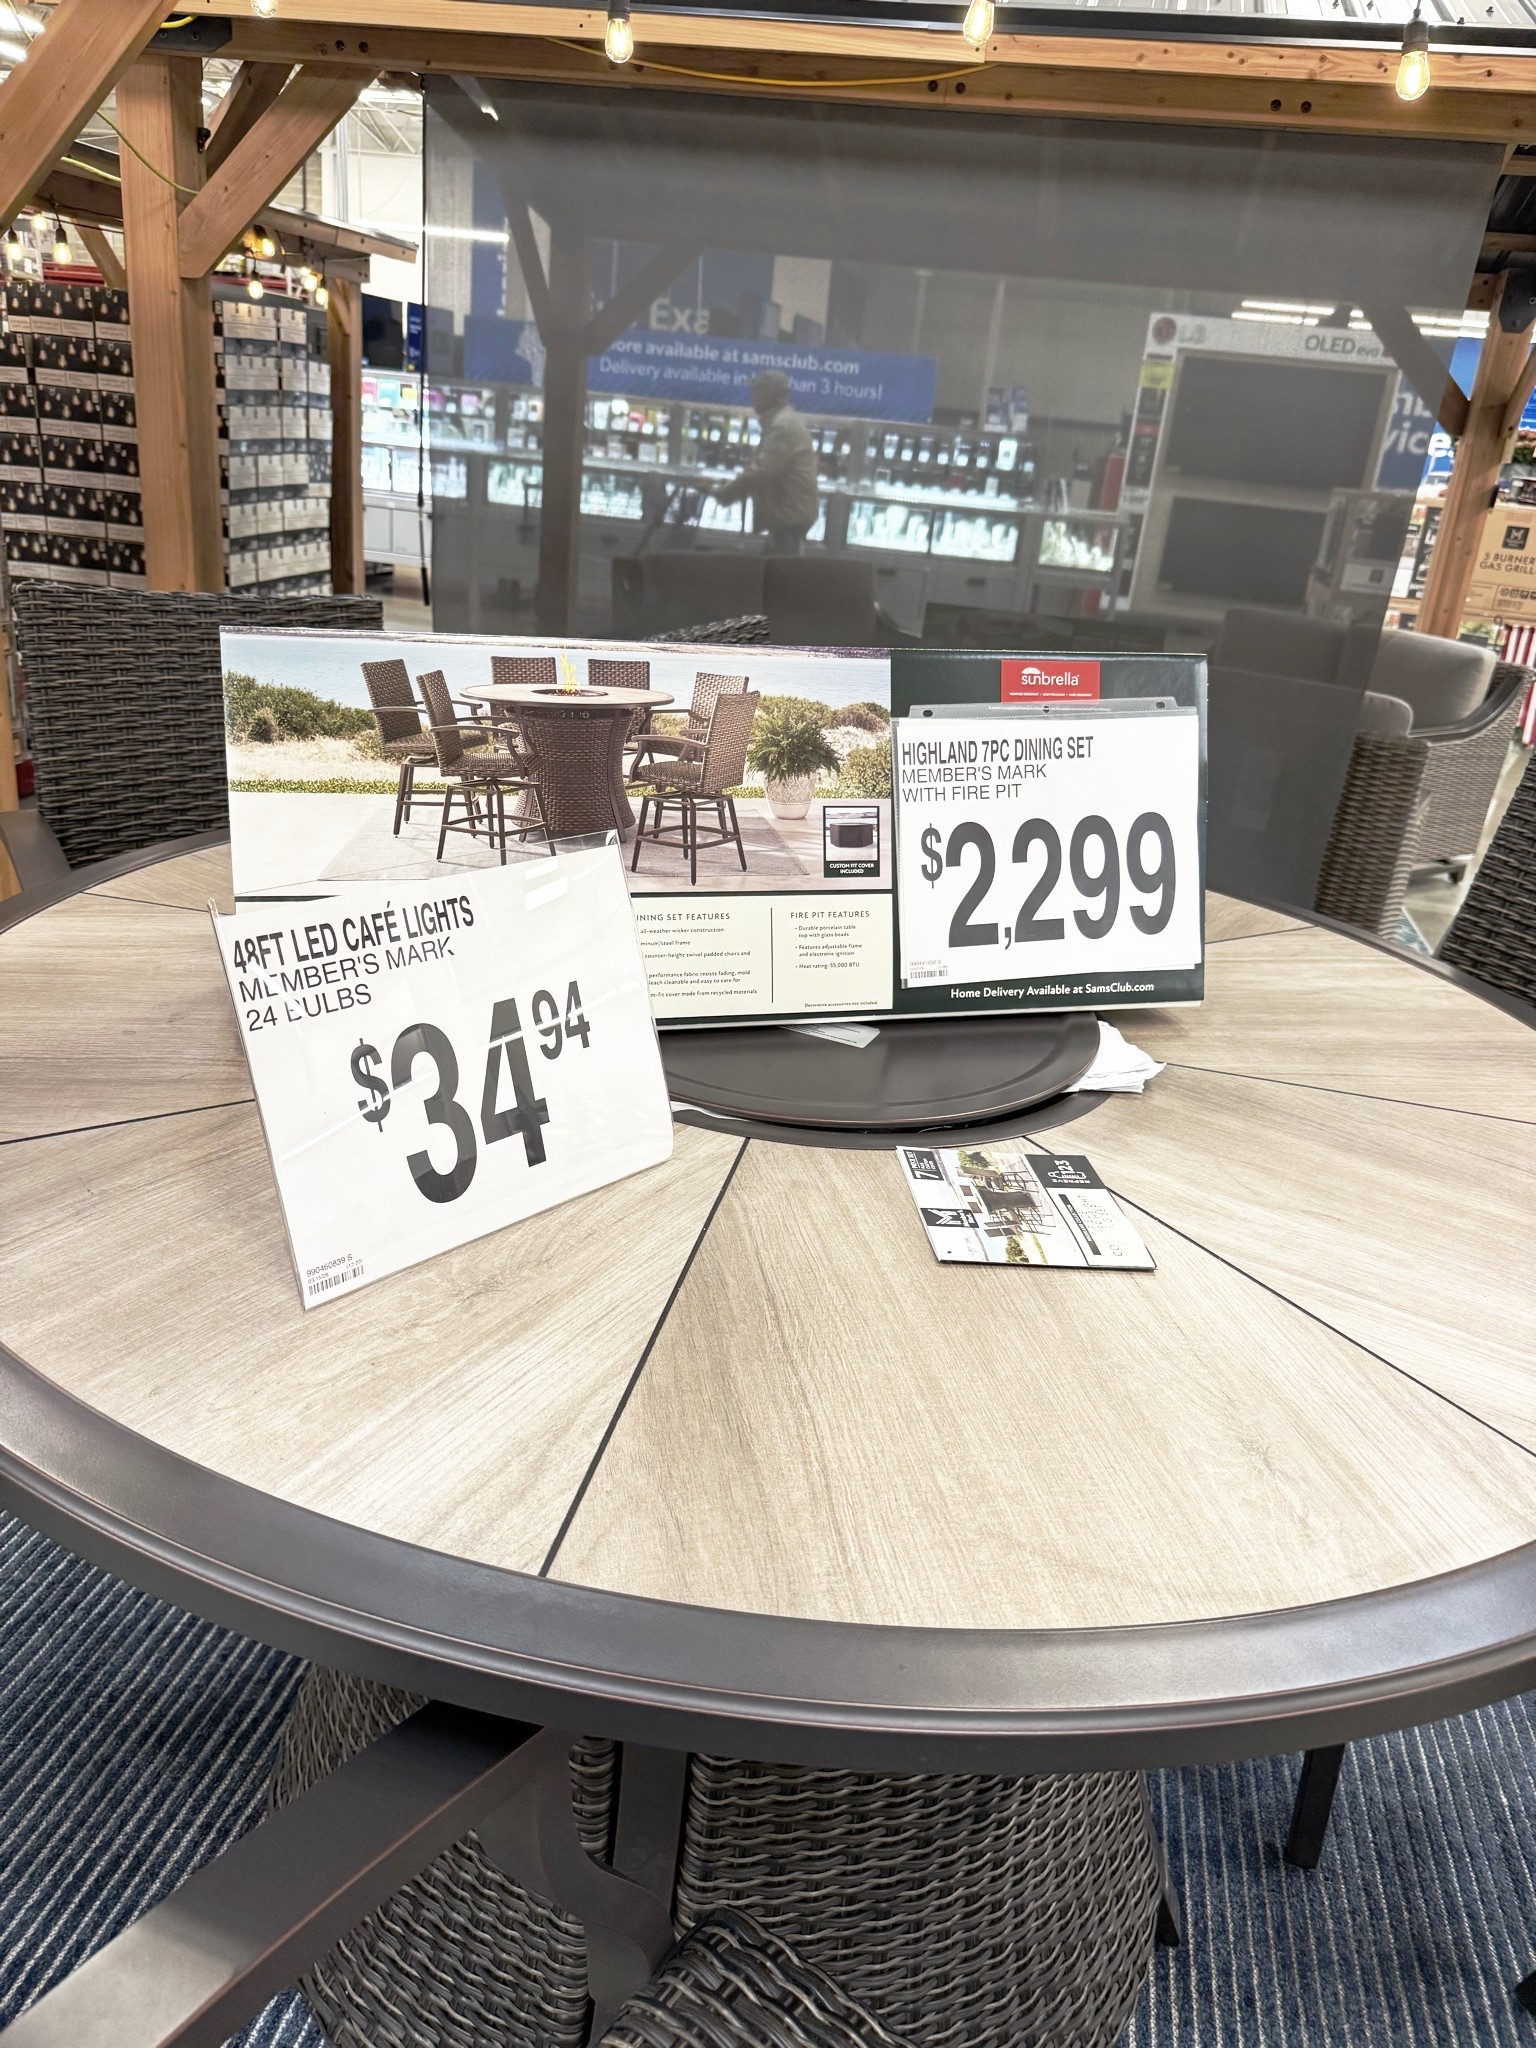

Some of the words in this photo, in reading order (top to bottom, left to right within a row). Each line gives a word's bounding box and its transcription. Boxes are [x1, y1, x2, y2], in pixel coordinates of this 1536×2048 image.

[650, 297, 709, 334] Exa
[1304, 334, 1356, 355] OLED
[610, 341, 642, 354] ore
[645, 342, 719, 361] available
[722, 350, 739, 363] at
[742, 353, 859, 375] samsclub.com
[600, 356, 659, 381] Delivery
[663, 364, 731, 385] available
[733, 369, 748, 386] in
[788, 378, 816, 393] han
[820, 378, 831, 395] 3
[833, 380, 884, 400] hours!
[1384, 421, 1454, 459] vice
[1480, 561, 1502, 571] GAS
[1505, 562, 1534, 575] GRILL
[1493, 554, 1536, 565] BURNER
[1021, 670, 1079, 686] sunbrella
[902, 740, 978, 766] HIGHLAND
[982, 739, 1010, 763] 7PC
[1014, 737, 1063, 762] DINING
[1067, 736, 1094, 759] SET
[902, 765, 992, 784] MEMBER'S
[997, 764, 1047, 780] MARK
[902, 786, 946, 803] WITH
[952, 785, 990, 801] FIRE
[996, 783, 1023, 799] PIT
[921, 811, 1176, 951] $2,299
[666, 913, 682, 921] SET
[686, 912, 731, 920] FEATURES
[790, 911, 809, 919] FIRE
[828, 910, 870, 918] FEATURES
[233, 931, 285, 974] 48FT
[290, 922, 338, 963] LED
[342, 901, 401, 952] CAFÉ
[402, 895, 474, 938] LIGHTS
[238, 953, 380, 1003] MEMBER'S
[385, 936, 455, 970] MARK
[950, 988, 981, 999] Home
[983, 987, 1025, 999] Delivery
[1026, 984, 1070, 996] Available
[1072, 985, 1084, 995] at
[1085, 982, 1154, 994] SamsClub.com
[246, 1005, 278, 1032] 24
[284, 983, 372, 1023] BULBS
[1054, 1160, 1076, 1174] 123
